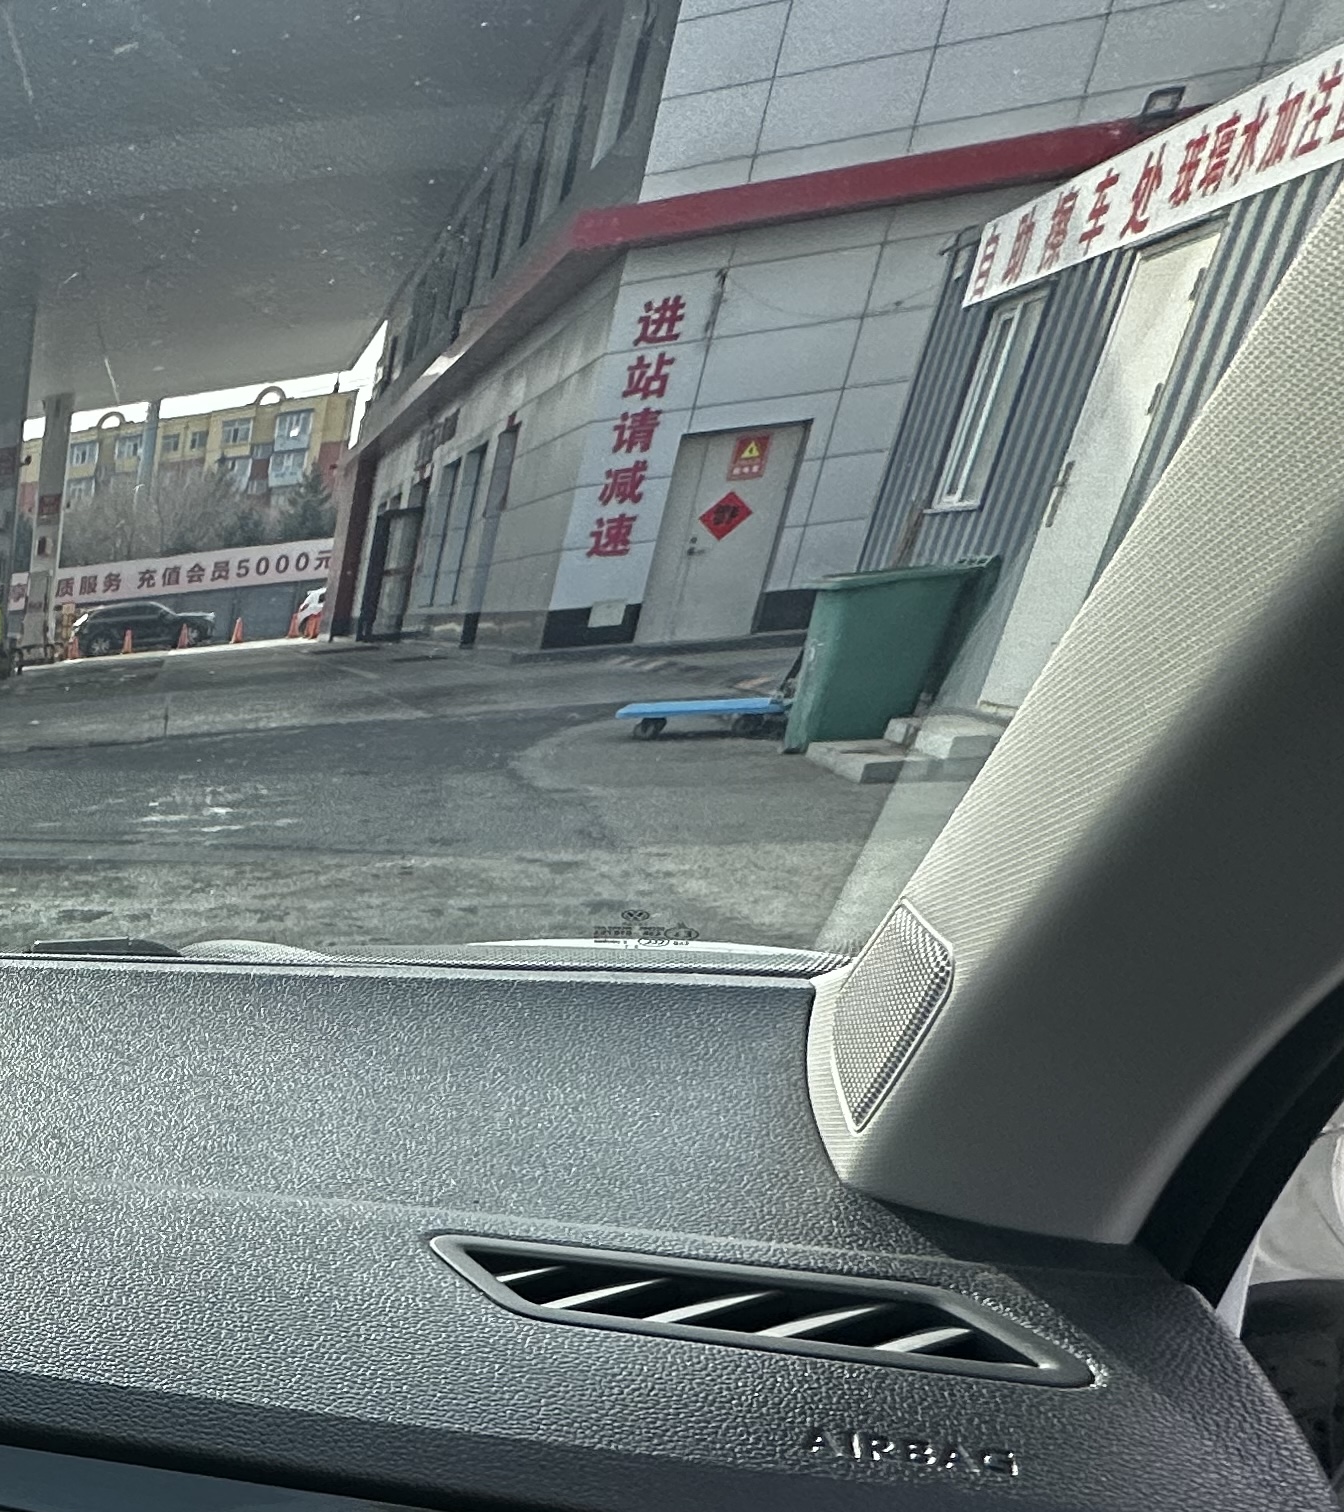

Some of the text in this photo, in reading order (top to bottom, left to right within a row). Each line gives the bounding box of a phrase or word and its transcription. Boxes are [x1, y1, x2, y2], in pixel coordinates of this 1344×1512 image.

[585, 296, 687, 559] 进站请减速
[137, 549, 333, 589] 充值会员5000元
[811, 1432, 1019, 1477] AIRBAG
